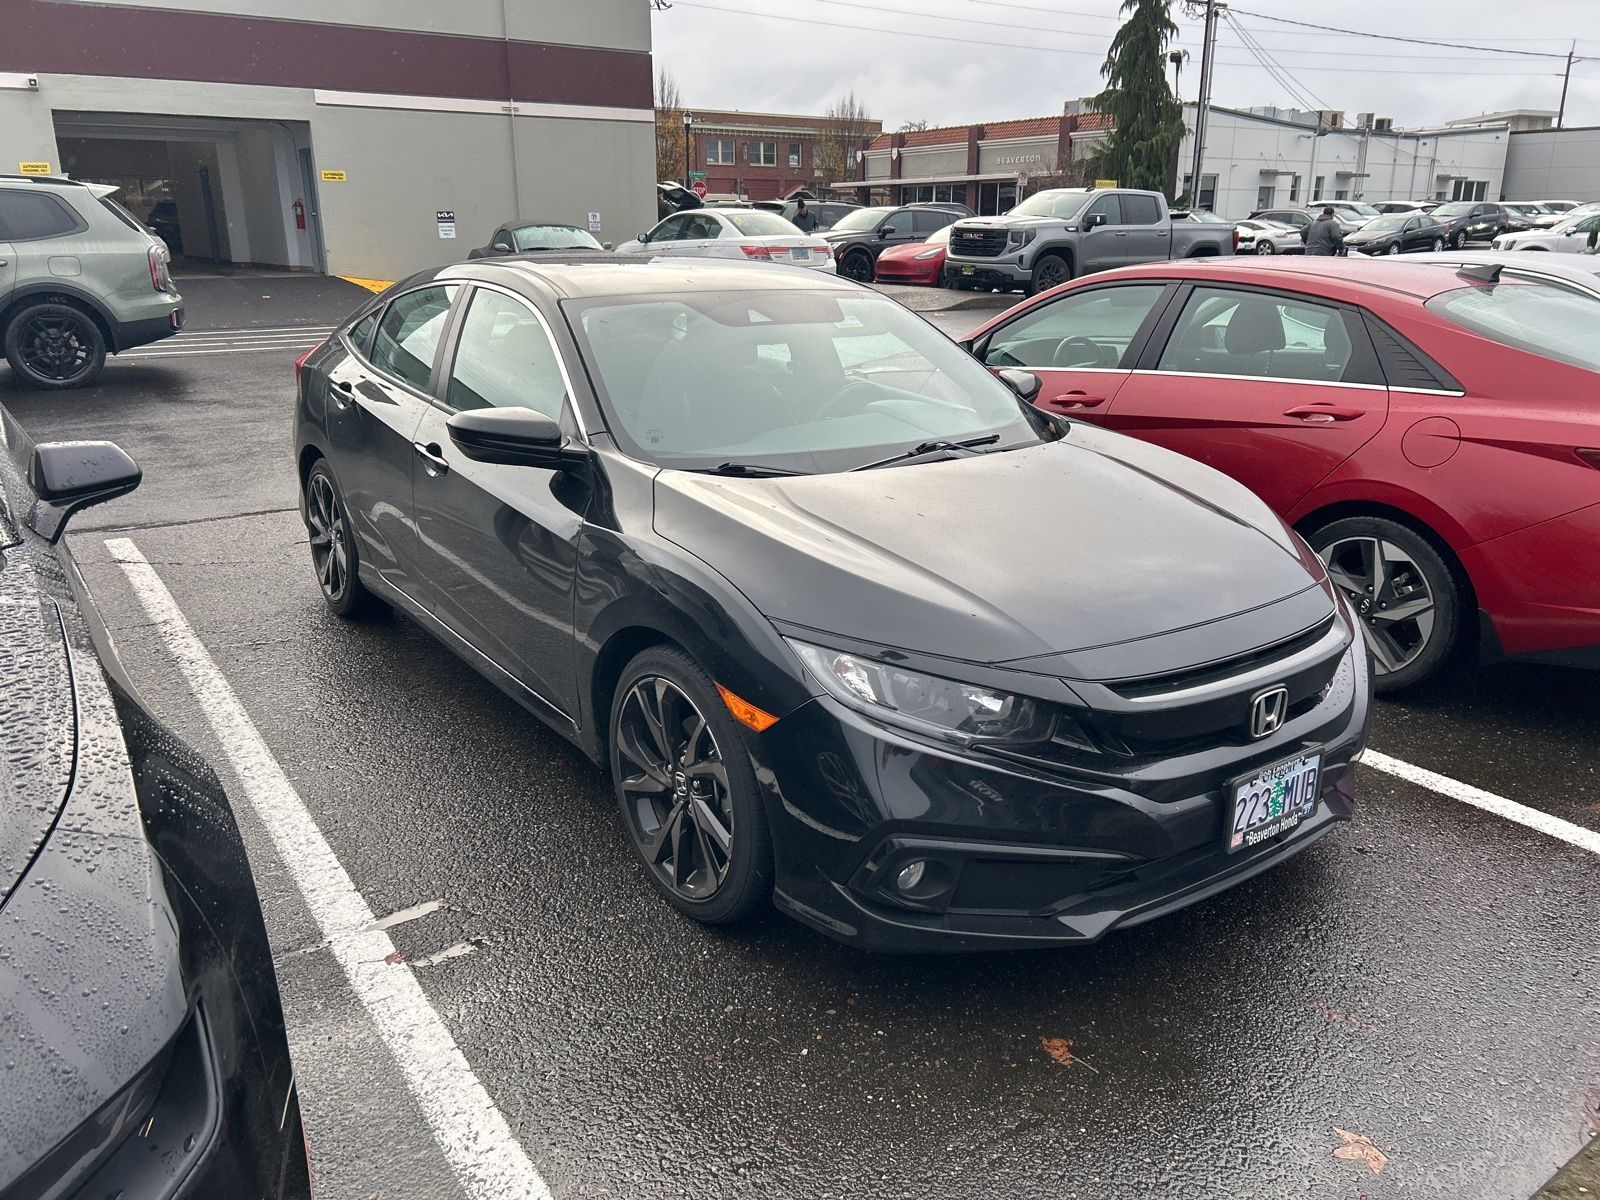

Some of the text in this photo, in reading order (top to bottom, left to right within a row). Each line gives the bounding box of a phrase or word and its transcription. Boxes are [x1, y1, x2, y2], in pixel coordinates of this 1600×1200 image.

[996, 154, 1041, 165] BEAVERTON
[692, 186, 706, 194] STOP
[1234, 767, 1317, 834] 223 MUB
